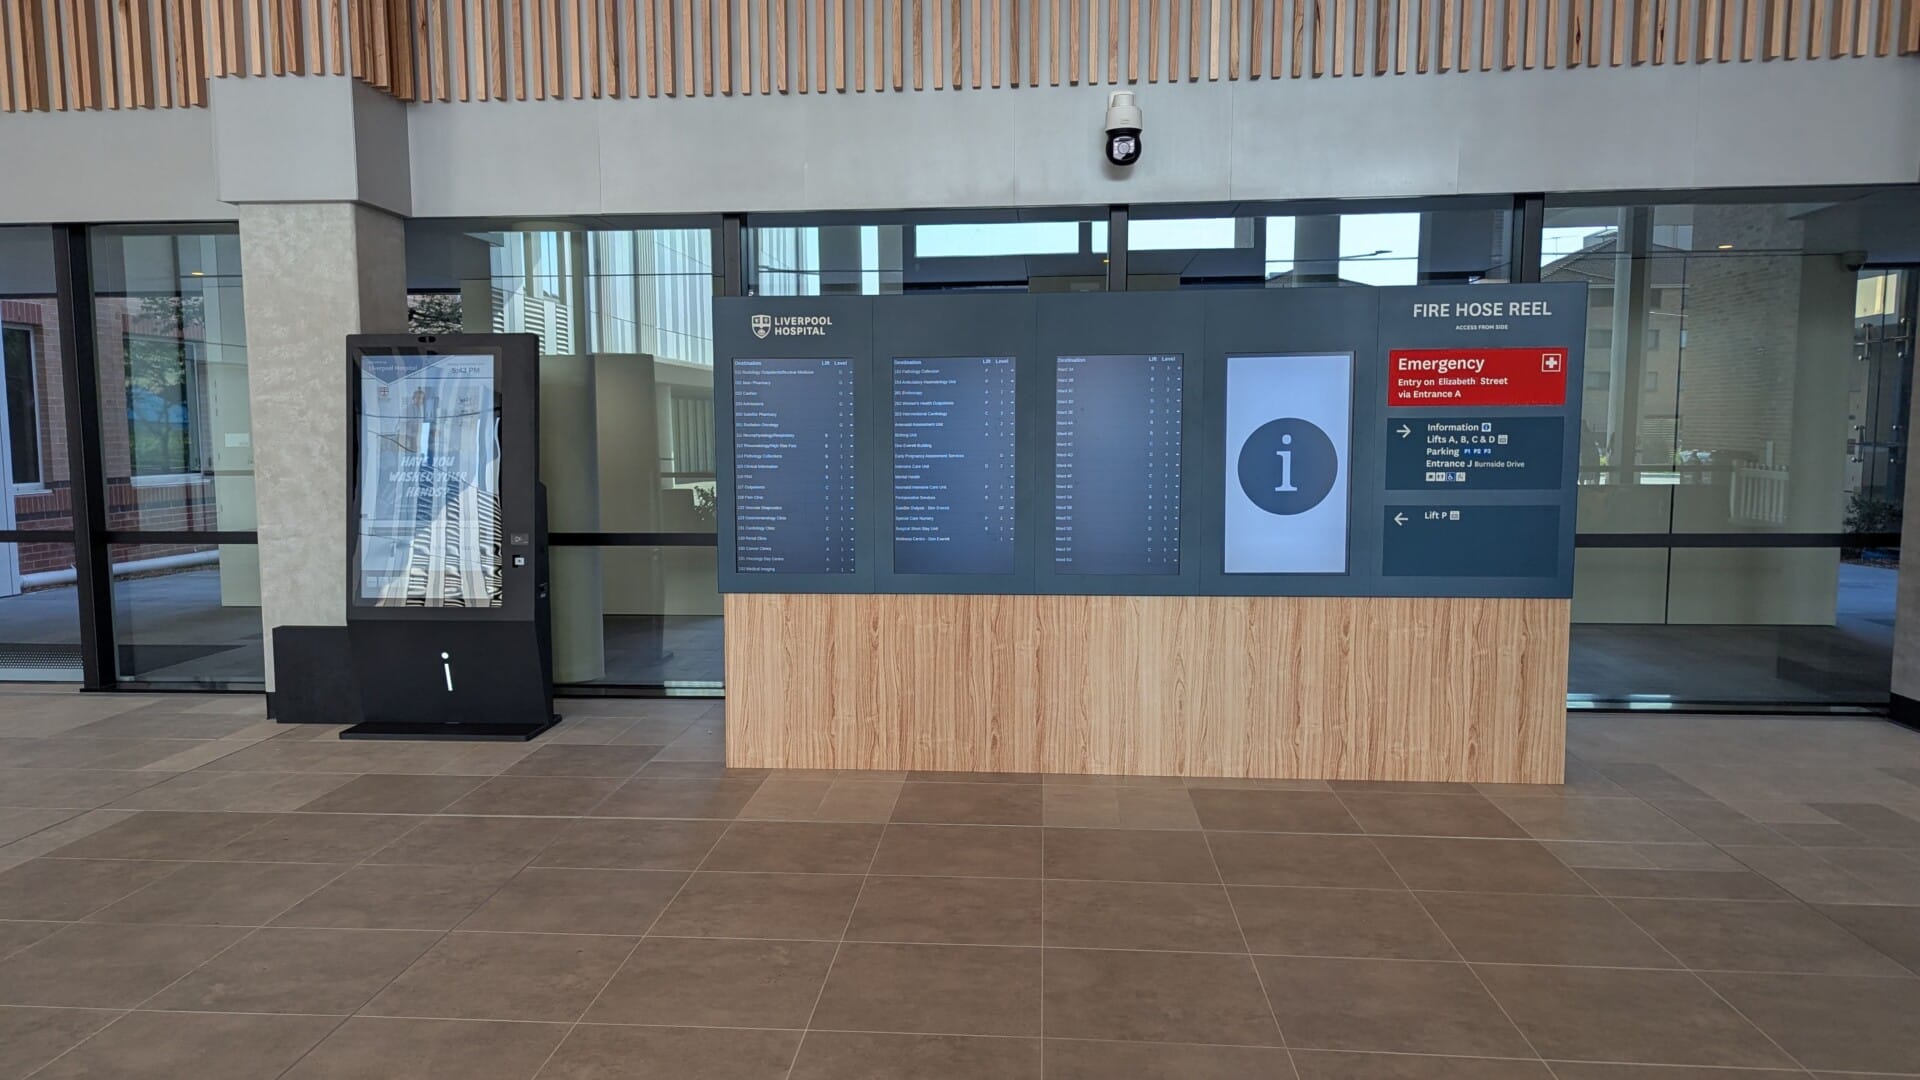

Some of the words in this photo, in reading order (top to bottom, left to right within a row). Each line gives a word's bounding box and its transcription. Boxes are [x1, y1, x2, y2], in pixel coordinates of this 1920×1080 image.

[1413, 303, 1450, 318] FIRE
[1455, 302, 1503, 317] HOSE
[1509, 301, 1552, 316] REEL
[774, 316, 833, 326] LIVERPOOL
[774, 326, 826, 336] HOSPITAL
[1398, 357, 1485, 373] Emergency
[1398, 378, 1422, 388] Entry
[1438, 376, 1476, 386] Elizabeth
[1480, 376, 1508, 385] Street
[1398, 390, 1411, 398] via
[1413, 389, 1453, 398] Entrance
[1454, 389, 1461, 398] A
[1427, 423, 1479, 432] Information
[1427, 436, 1447, 444] Lifts
[1448, 436, 1458, 445] A,
[1460, 435, 1470, 445] B,
[1471, 435, 1479, 444] C
[1480, 435, 1487, 443] &
[1488, 435, 1496, 444] D
[1426, 447, 1460, 458] Parking
[401, 456, 429, 467] HAVE
[432, 456, 456, 467] YOU
[1426, 459, 1465, 468] Entrance
[1466, 459, 1473, 468] J
[1474, 460, 1505, 468] Burnside
[1506, 460, 1525, 468] Drive
[389, 471, 433, 482] WASHED
[1424, 511, 1440, 520] Lift
[1441, 511, 1448, 520] P
